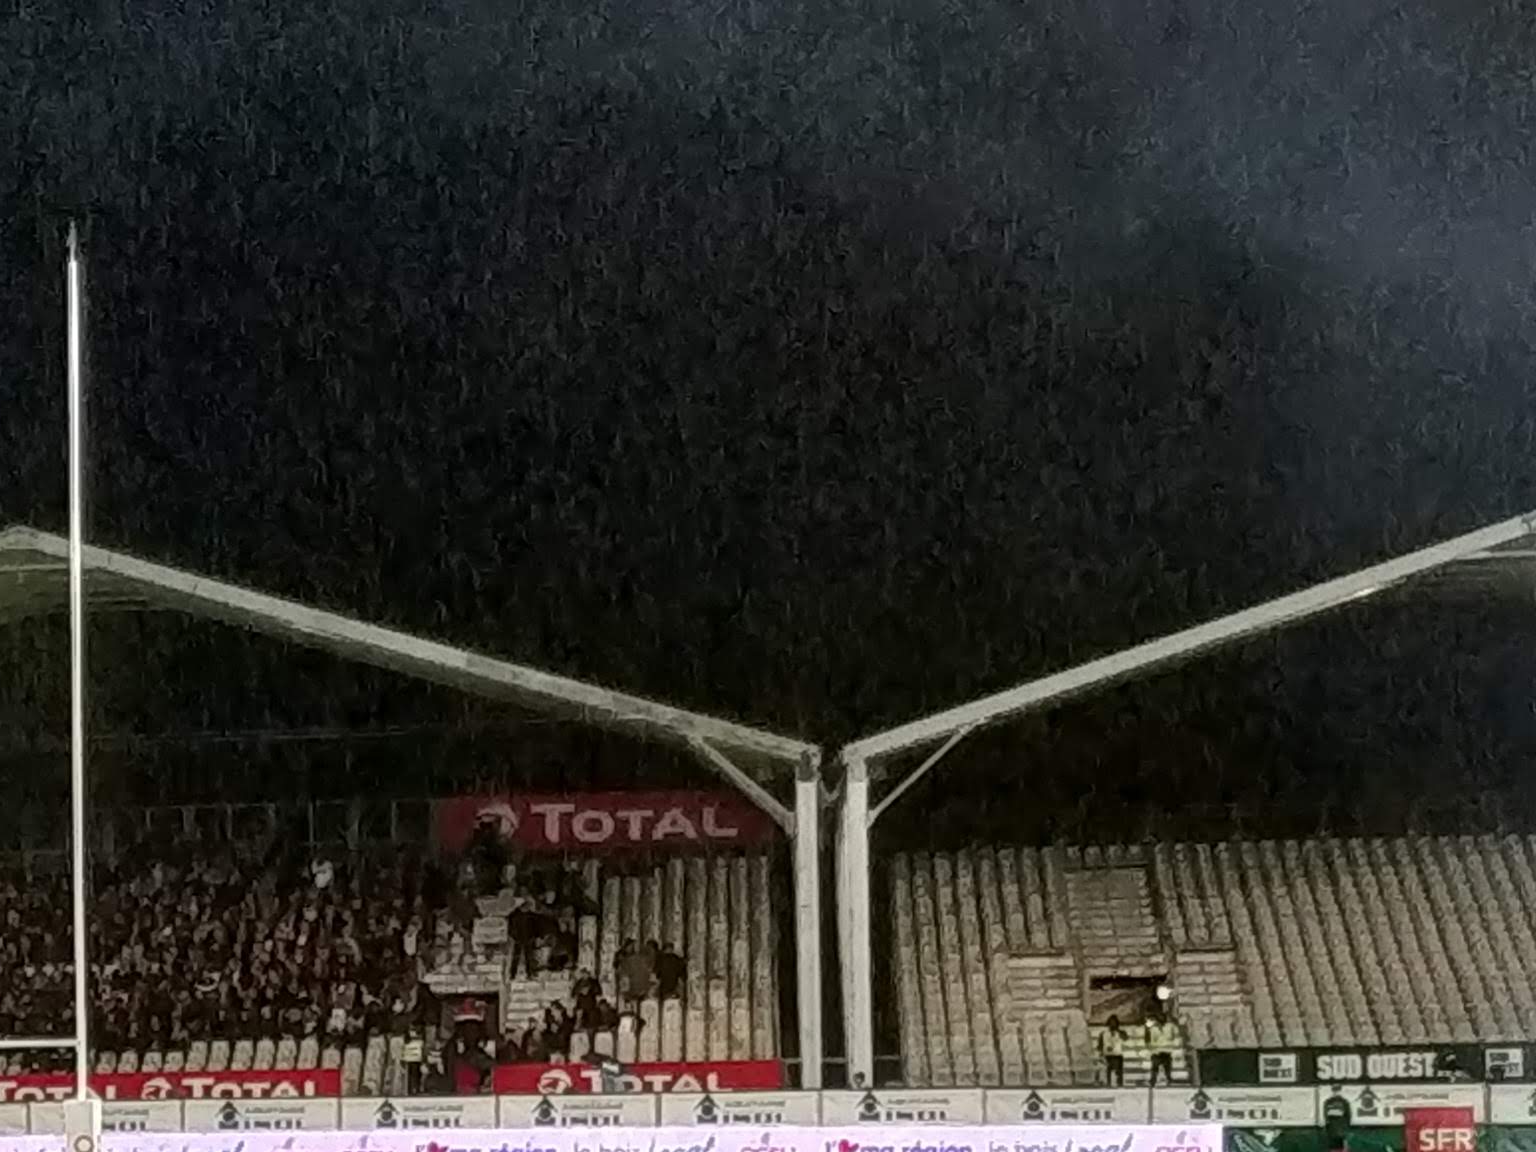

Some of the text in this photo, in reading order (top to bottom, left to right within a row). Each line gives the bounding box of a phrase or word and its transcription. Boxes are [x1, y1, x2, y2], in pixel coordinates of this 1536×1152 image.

[530, 803, 738, 843] TOTAL
[1317, 1053, 1363, 1080] SUD
[1366, 1052, 1438, 1079] OUEST
[1419, 1128, 1472, 1151] SFR
